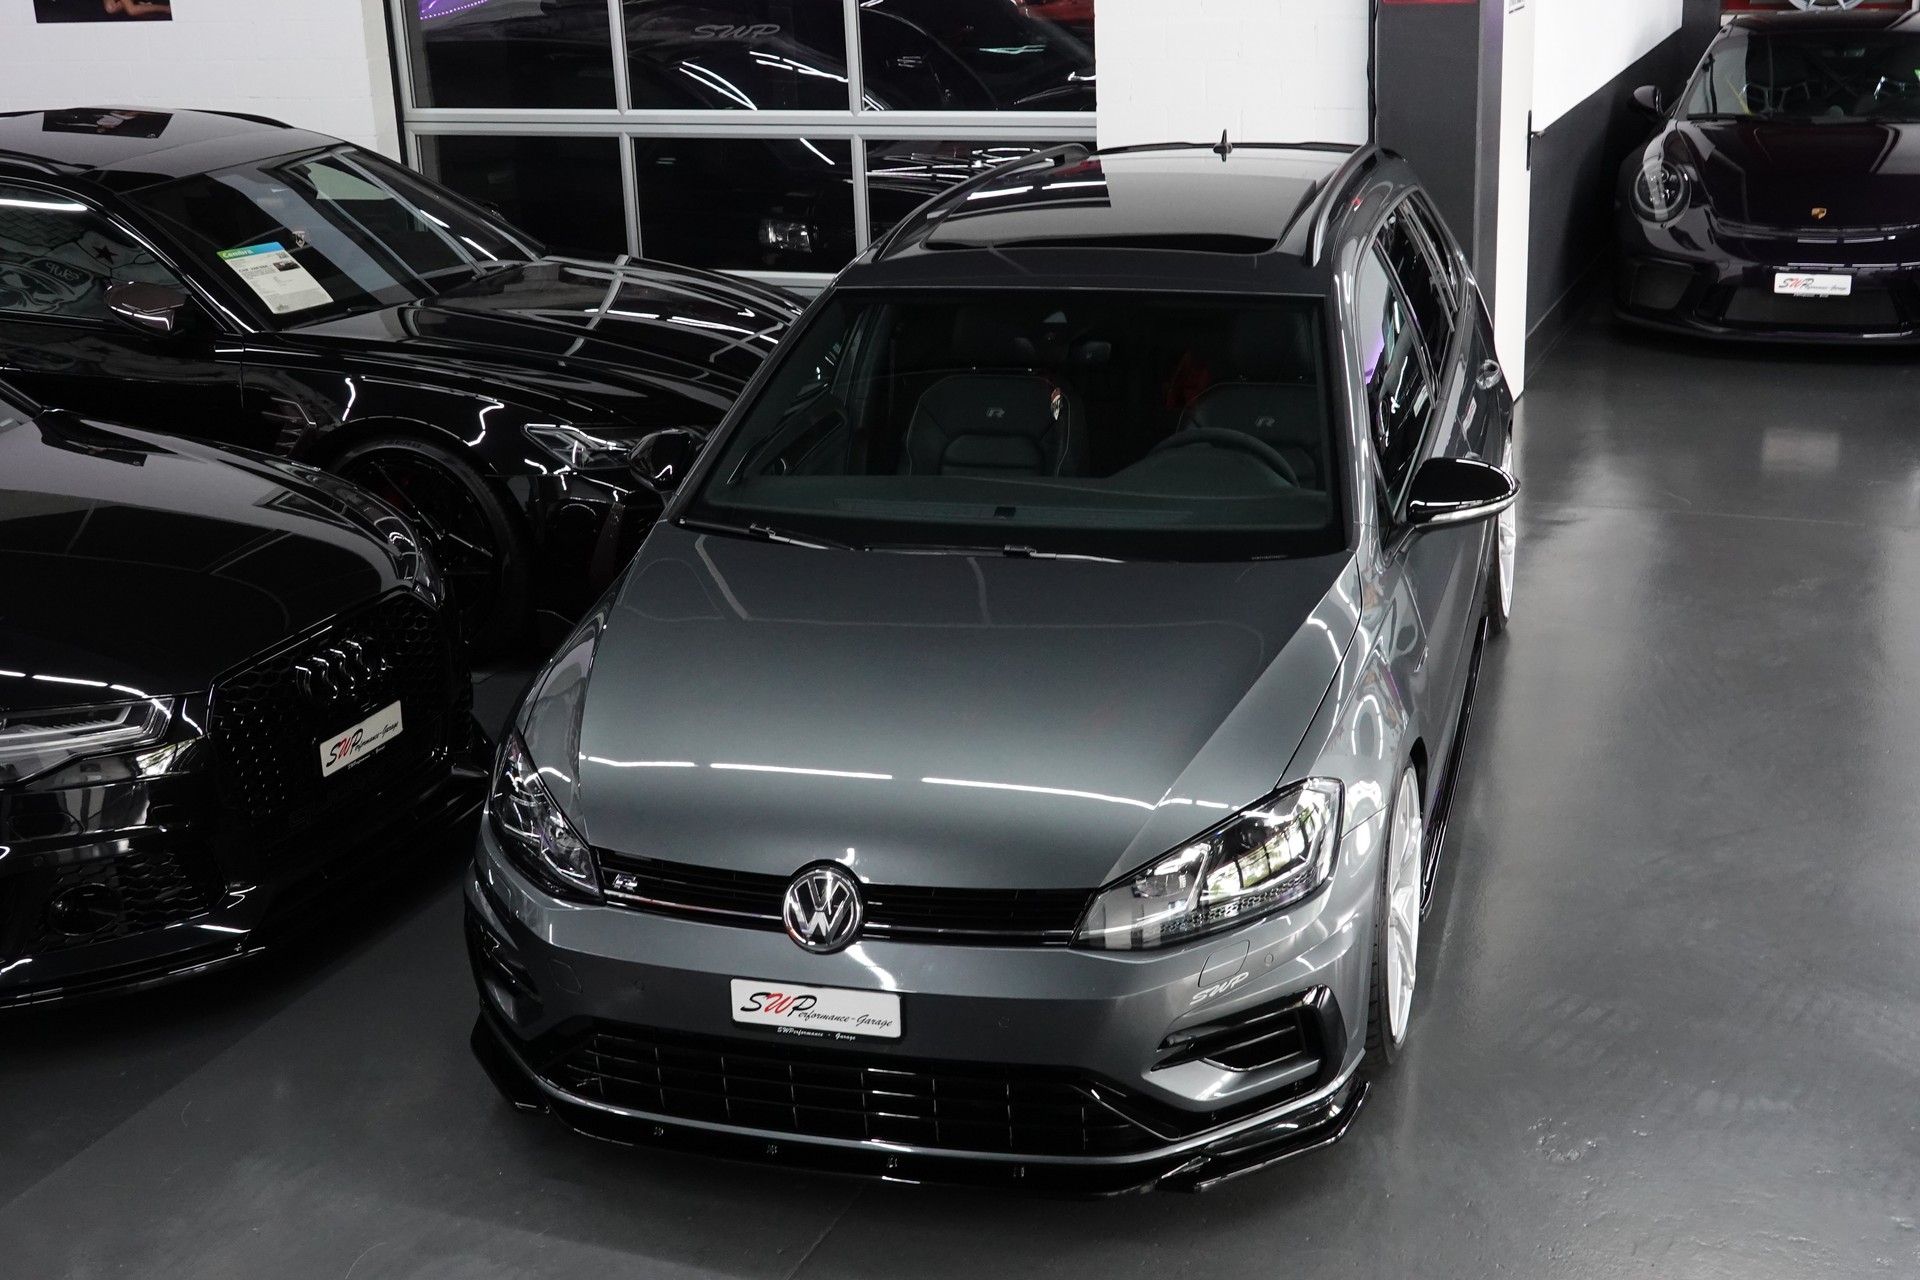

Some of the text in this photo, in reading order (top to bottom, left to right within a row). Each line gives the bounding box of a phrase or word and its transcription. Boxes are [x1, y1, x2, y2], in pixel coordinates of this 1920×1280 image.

[690, 24, 780, 38] SWP
[788, 872, 857, 947] VW
[1190, 972, 1249, 1005] SWP
